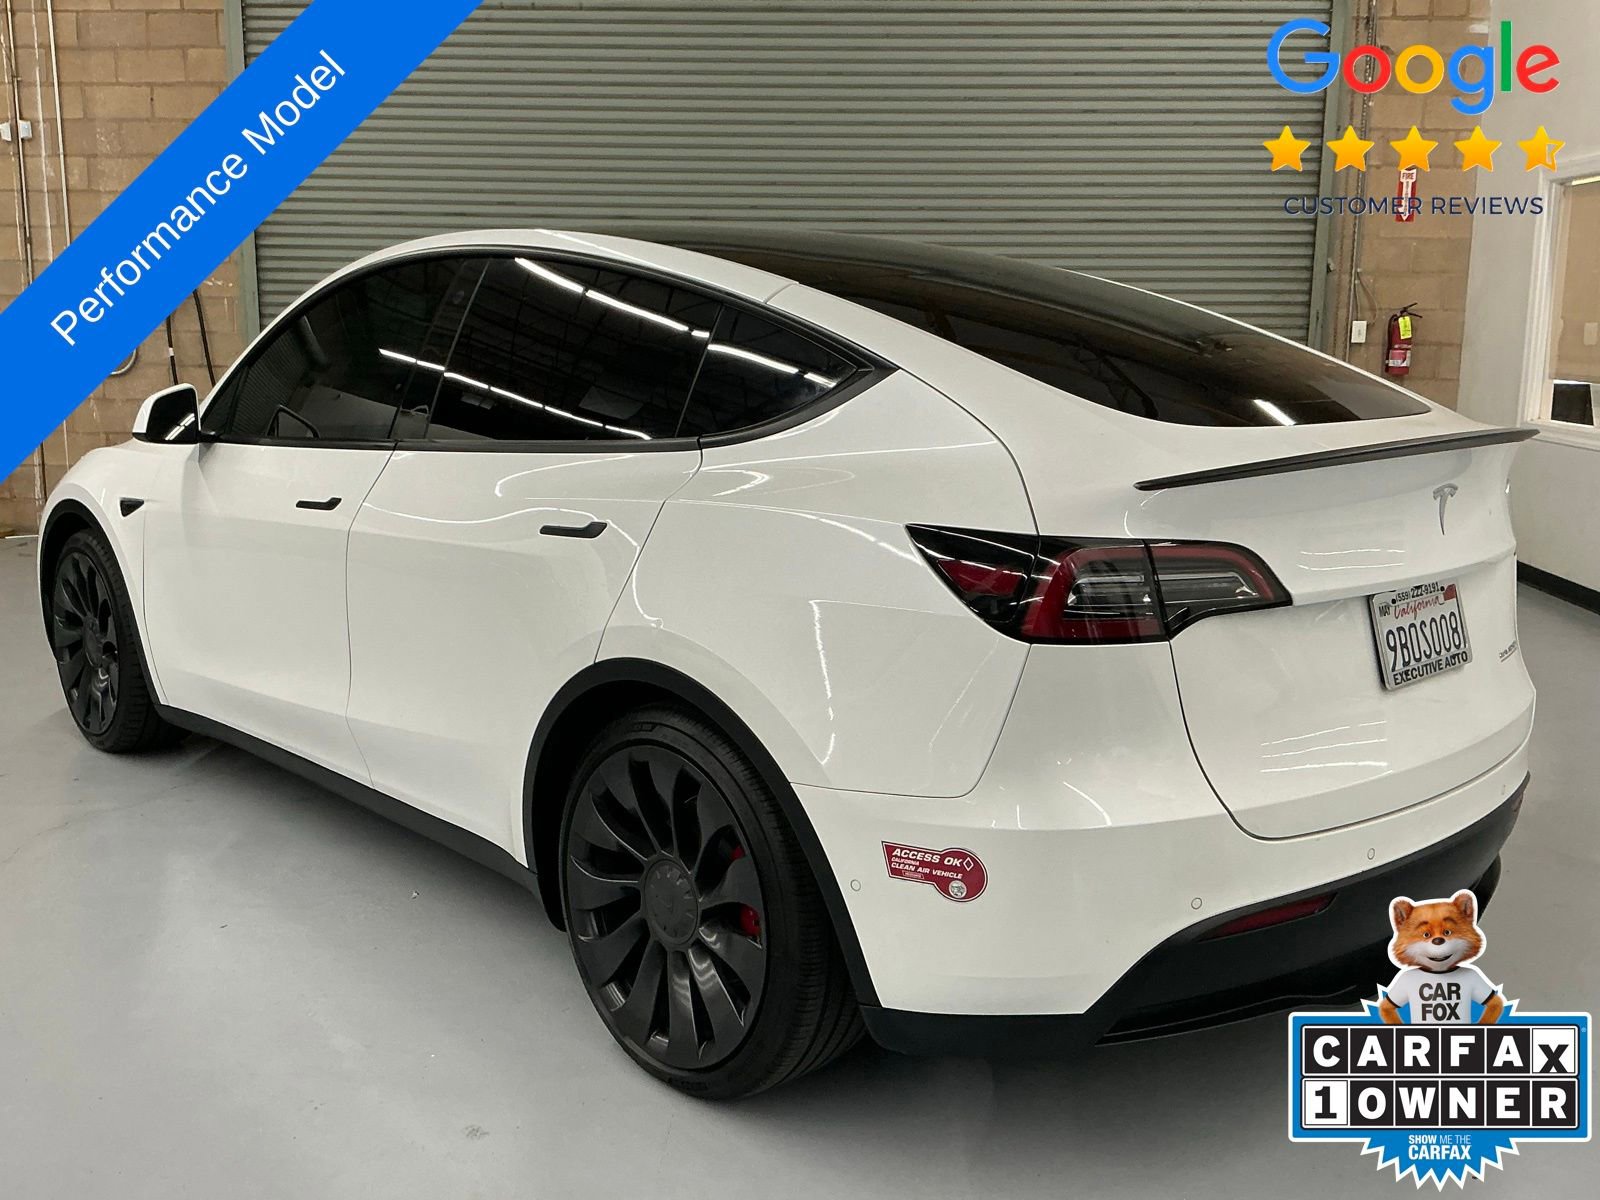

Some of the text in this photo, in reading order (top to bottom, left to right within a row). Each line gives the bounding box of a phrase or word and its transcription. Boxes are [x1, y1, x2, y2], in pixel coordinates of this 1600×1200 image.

[1393, 595, 1444, 621] California
[1393, 650, 1468, 686] EXECUTIVE AUTO
[892, 848, 962, 867] ACCESS OK
[891, 862, 915, 871] CLEAN
[932, 869, 963, 879] VEHICLE
